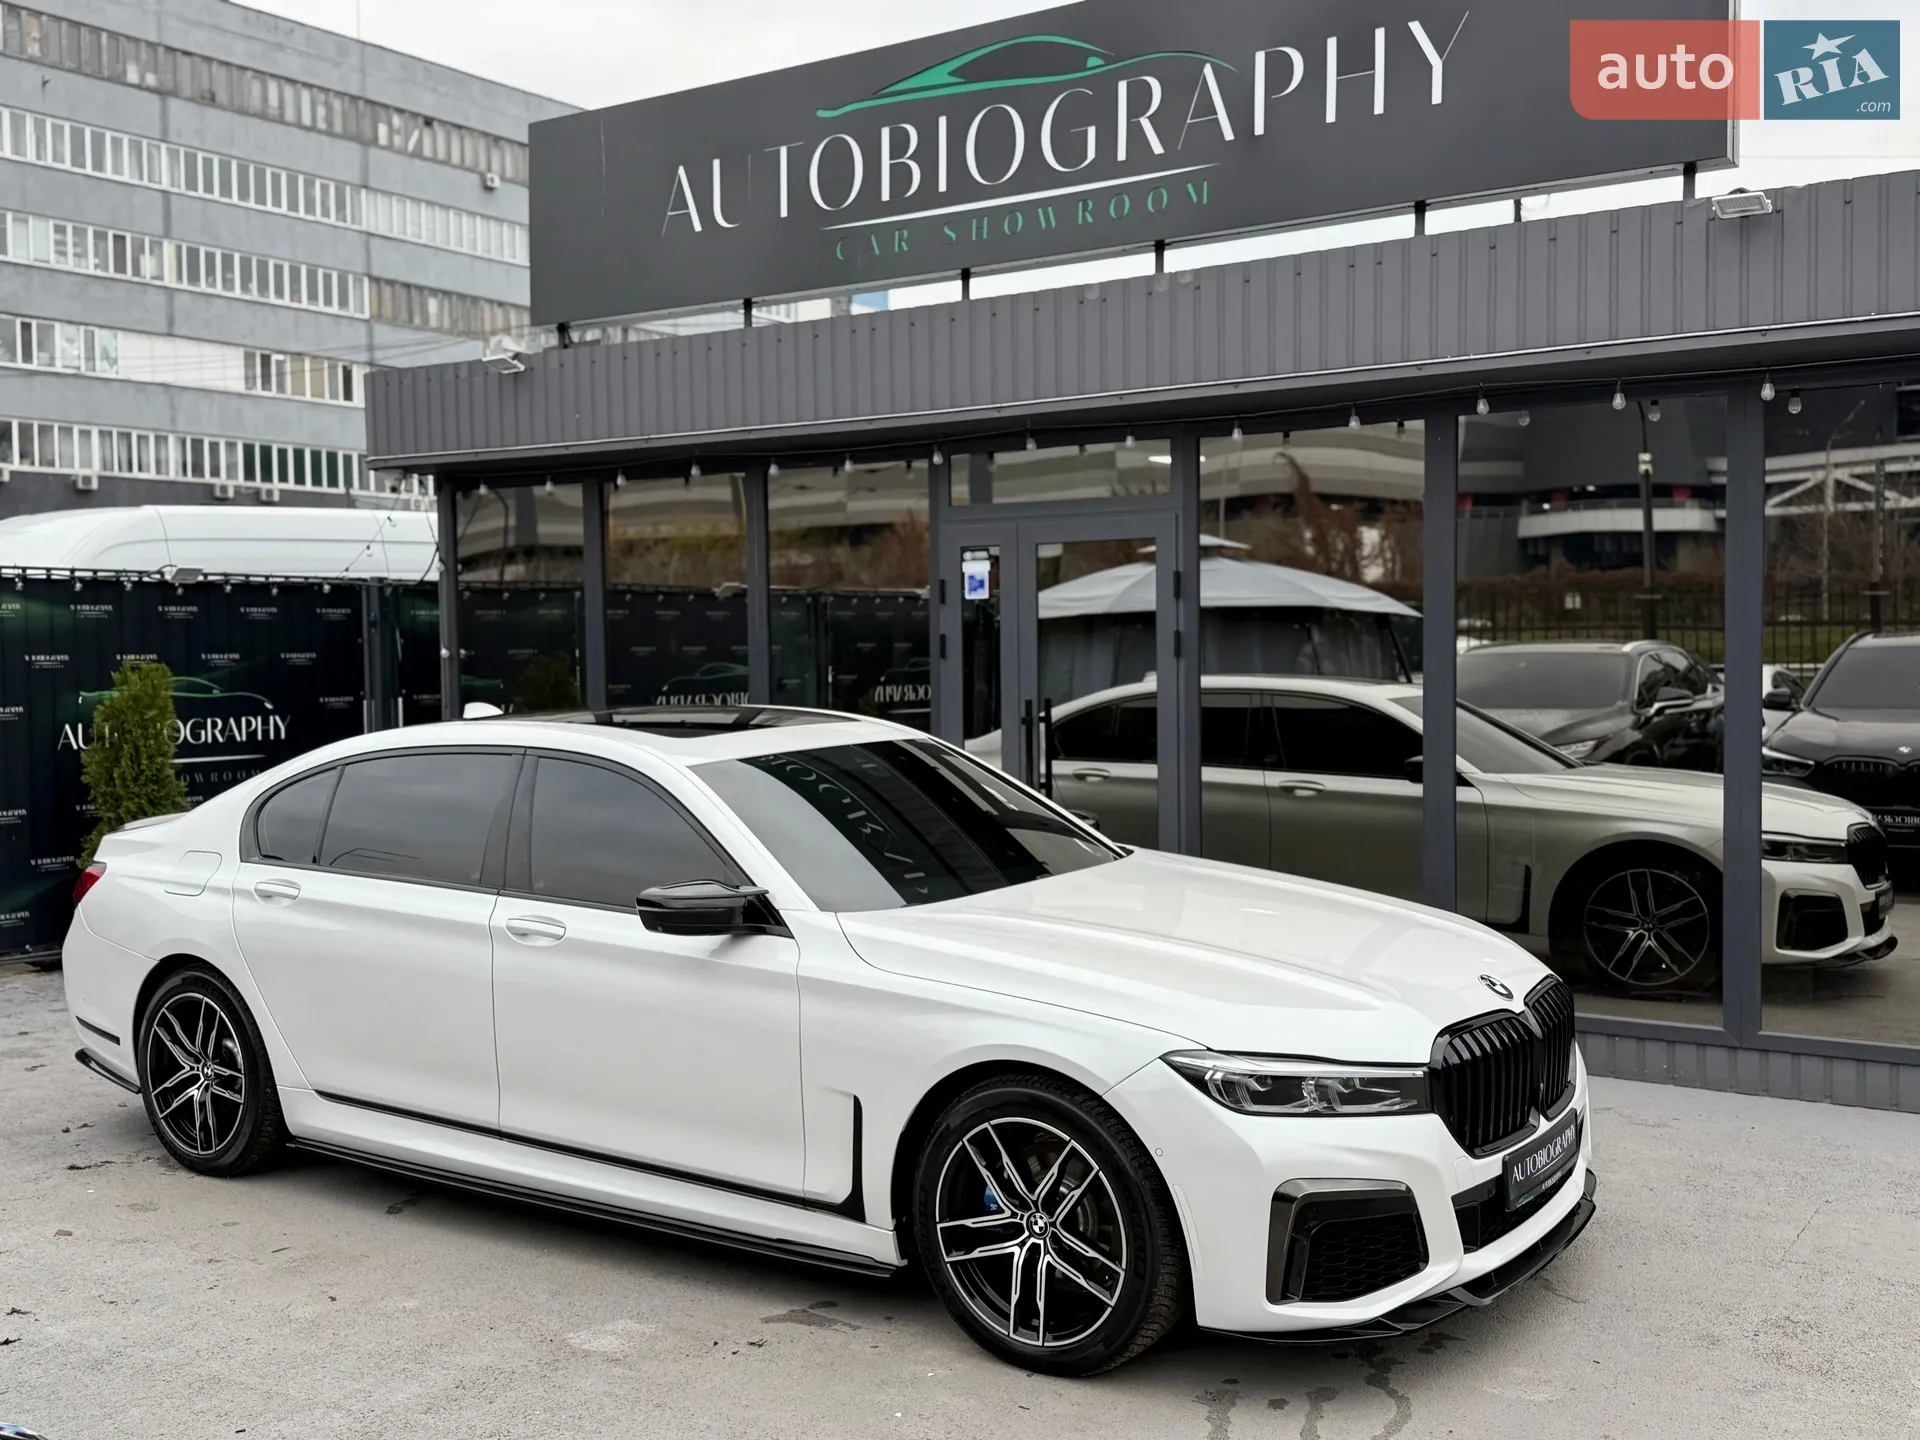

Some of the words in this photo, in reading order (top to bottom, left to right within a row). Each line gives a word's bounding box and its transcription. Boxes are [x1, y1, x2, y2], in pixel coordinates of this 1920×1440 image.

[662, 10, 1470, 238] AUTOBIOGRAPHY
[834, 228, 910, 266] CAR
[942, 179, 1210, 246] SHOWROOM
[1511, 1123, 1576, 1185] AUTOBIOGRAPHY
